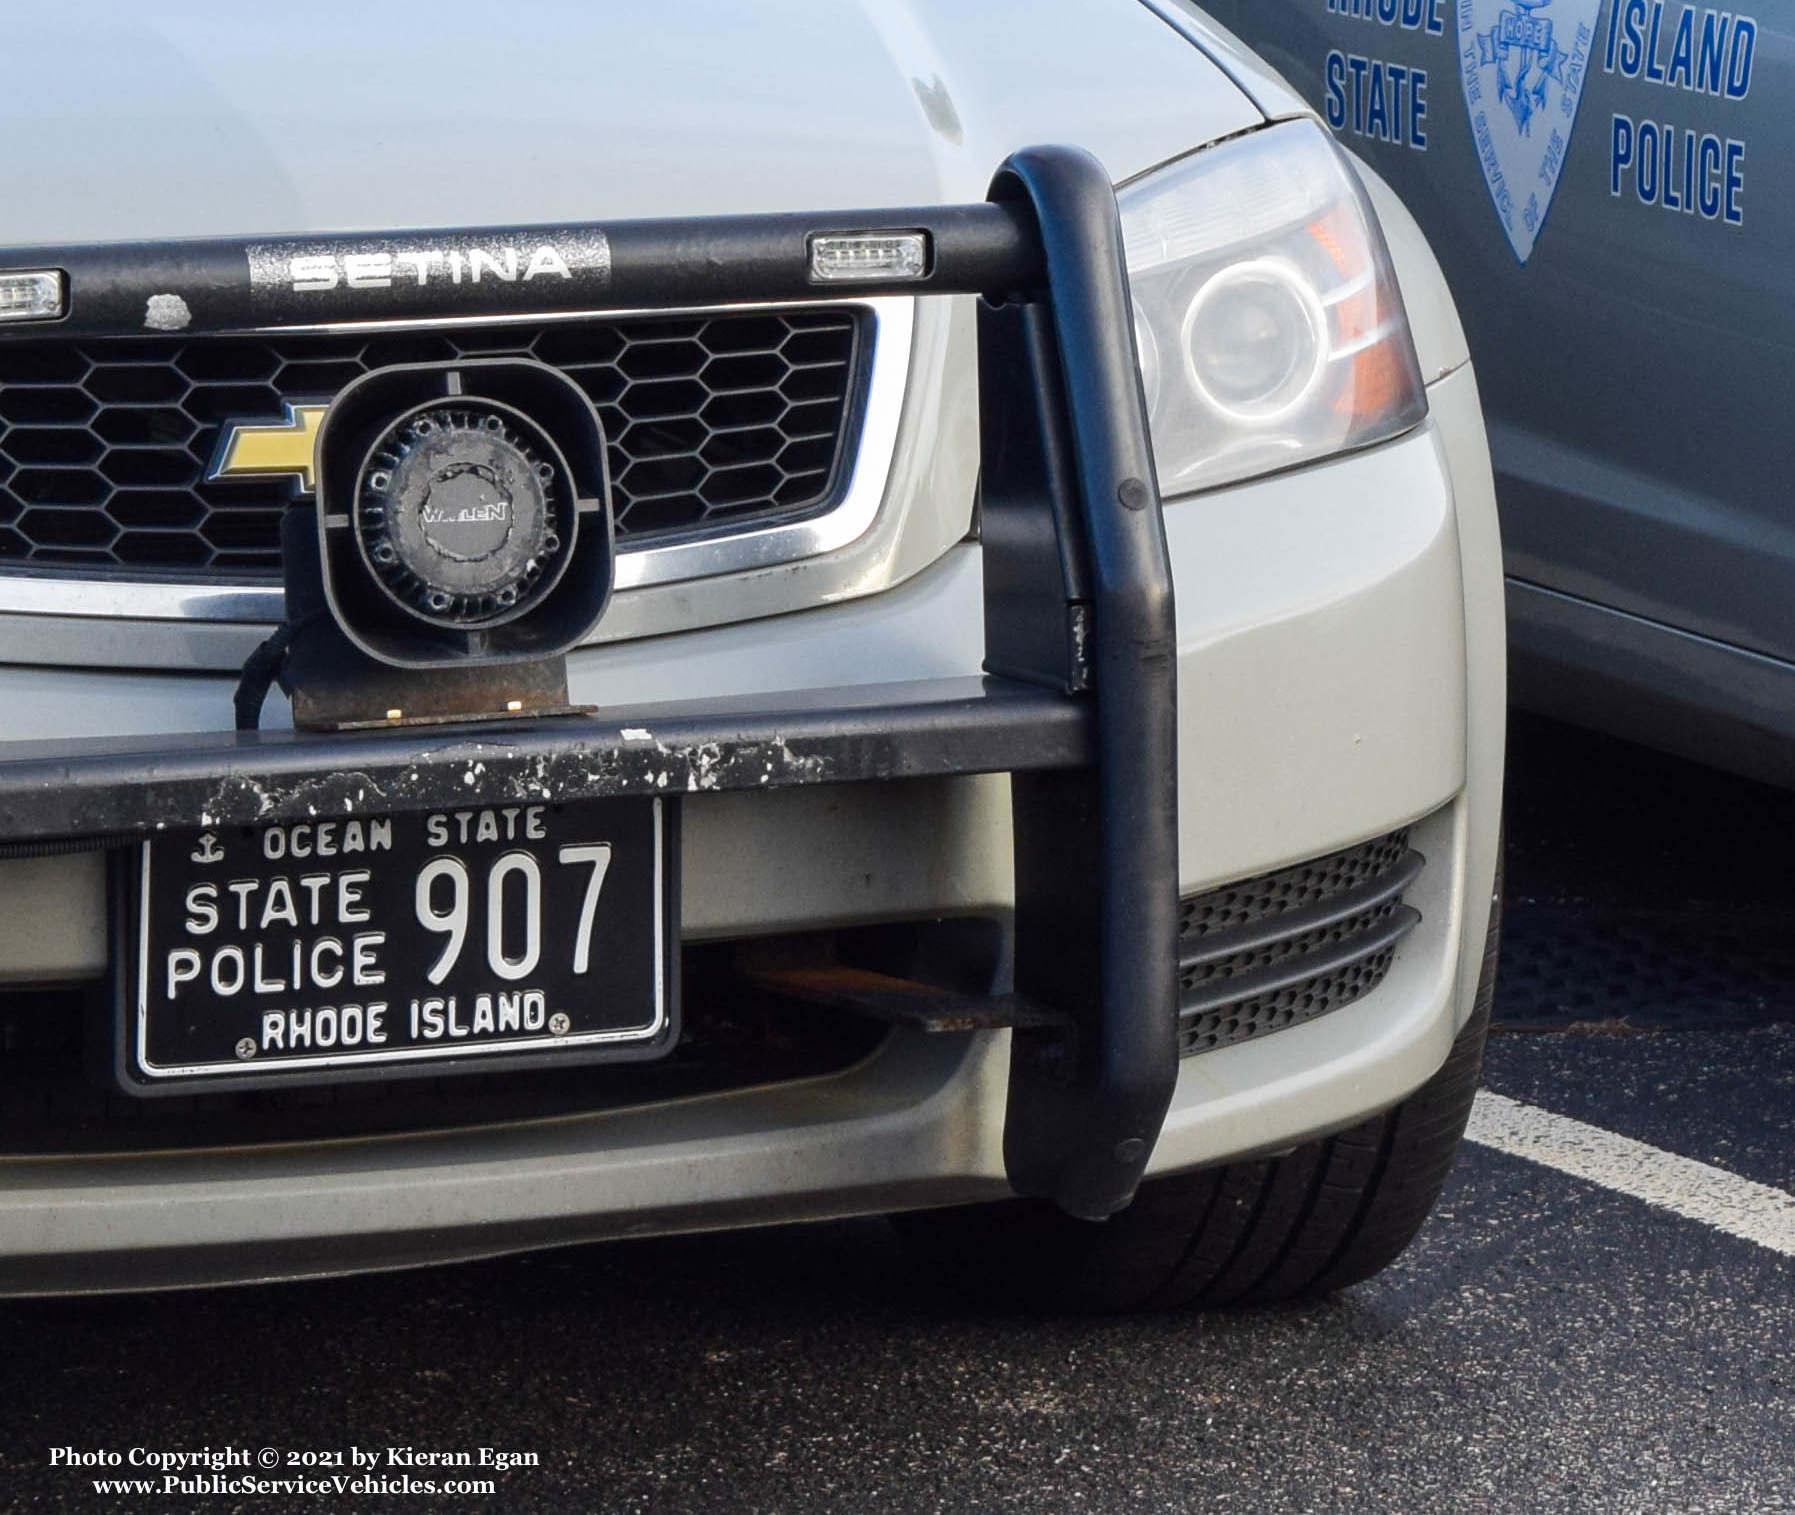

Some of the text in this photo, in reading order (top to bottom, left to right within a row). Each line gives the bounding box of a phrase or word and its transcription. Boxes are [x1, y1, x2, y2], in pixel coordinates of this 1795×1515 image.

[1325, 49, 1745, 226] STATE POLICE
[290, 246, 573, 292] SETINA
[263, 806, 546, 860] OCEAN STATE
[185, 871, 370, 935] STATE
[415, 842, 613, 986] 907
[167, 932, 386, 1000] POLICE
[262, 991, 545, 1050] RHODE ISLAND
